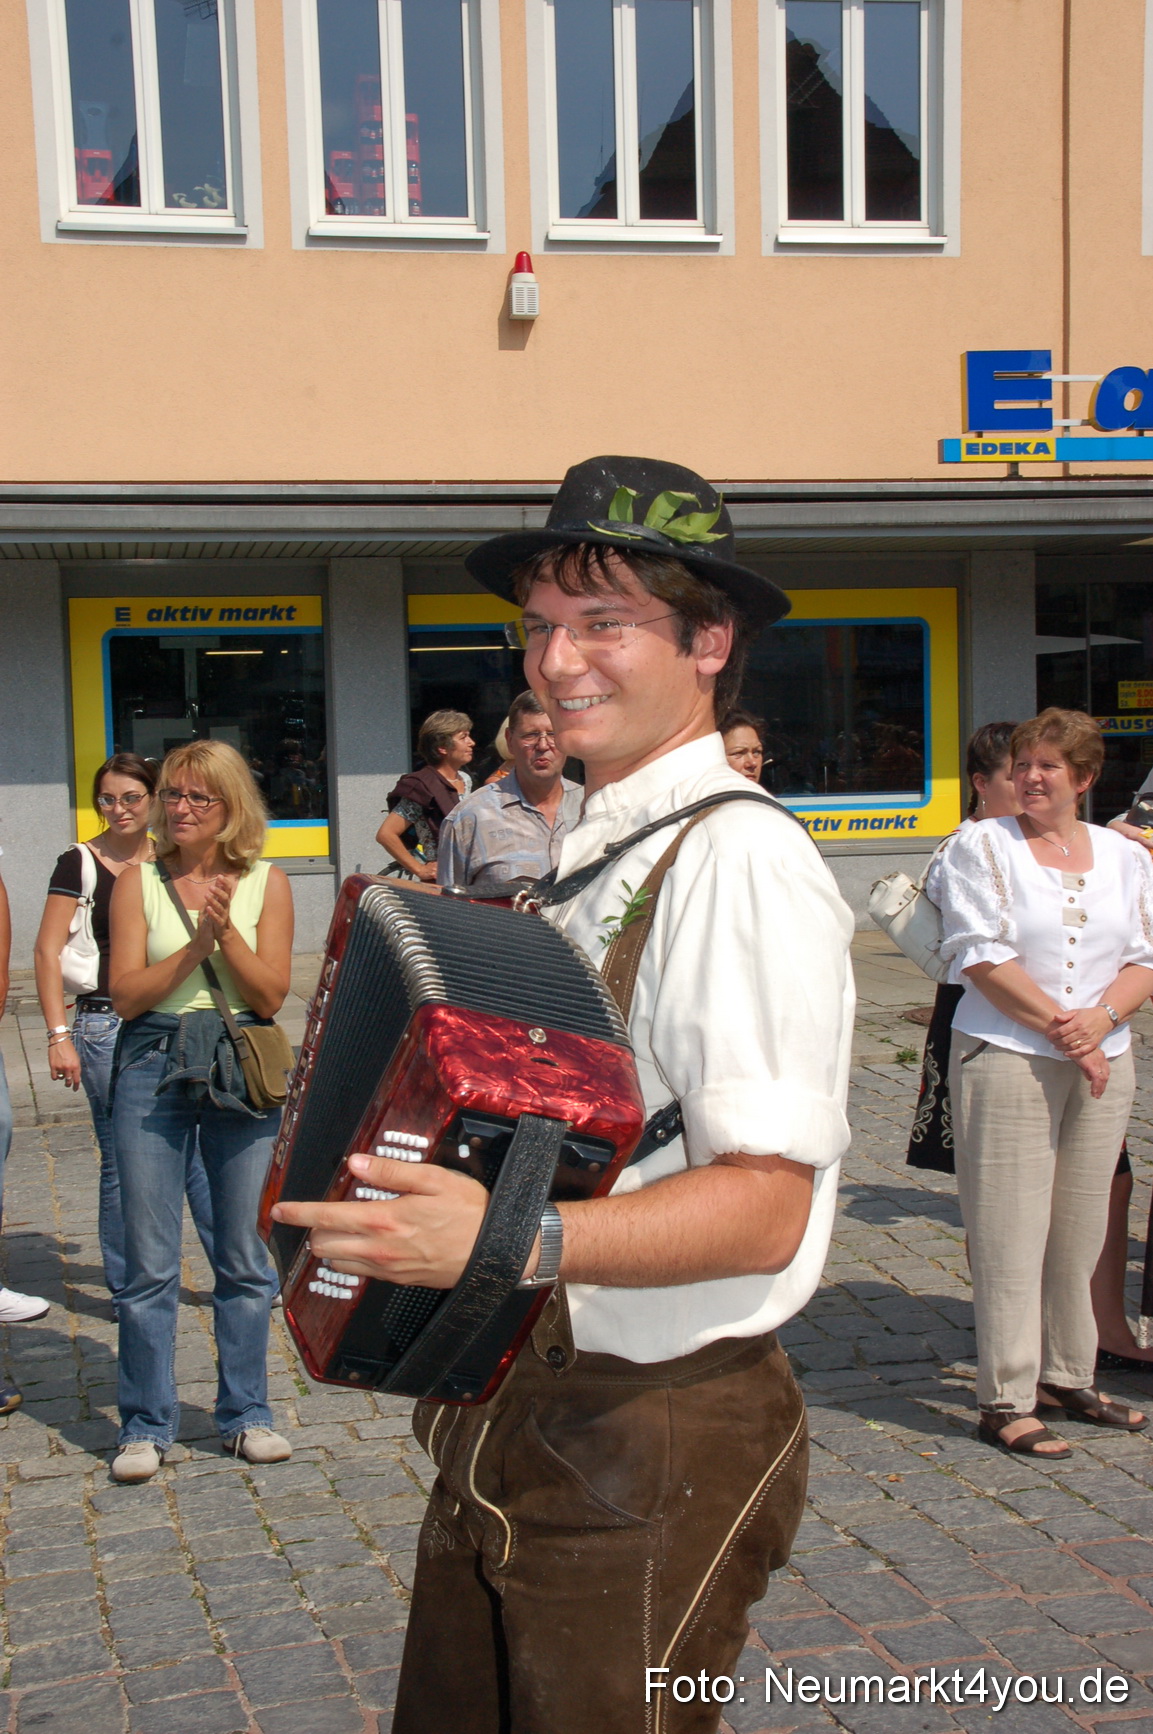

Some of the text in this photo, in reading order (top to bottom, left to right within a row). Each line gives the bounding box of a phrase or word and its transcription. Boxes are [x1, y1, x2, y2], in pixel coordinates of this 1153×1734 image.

[961, 350, 1053, 433] E
[965, 442, 1051, 456] EDEKA
[115, 604, 297, 622] E aktiv markt
[799, 814, 919, 832] ktiv markt
